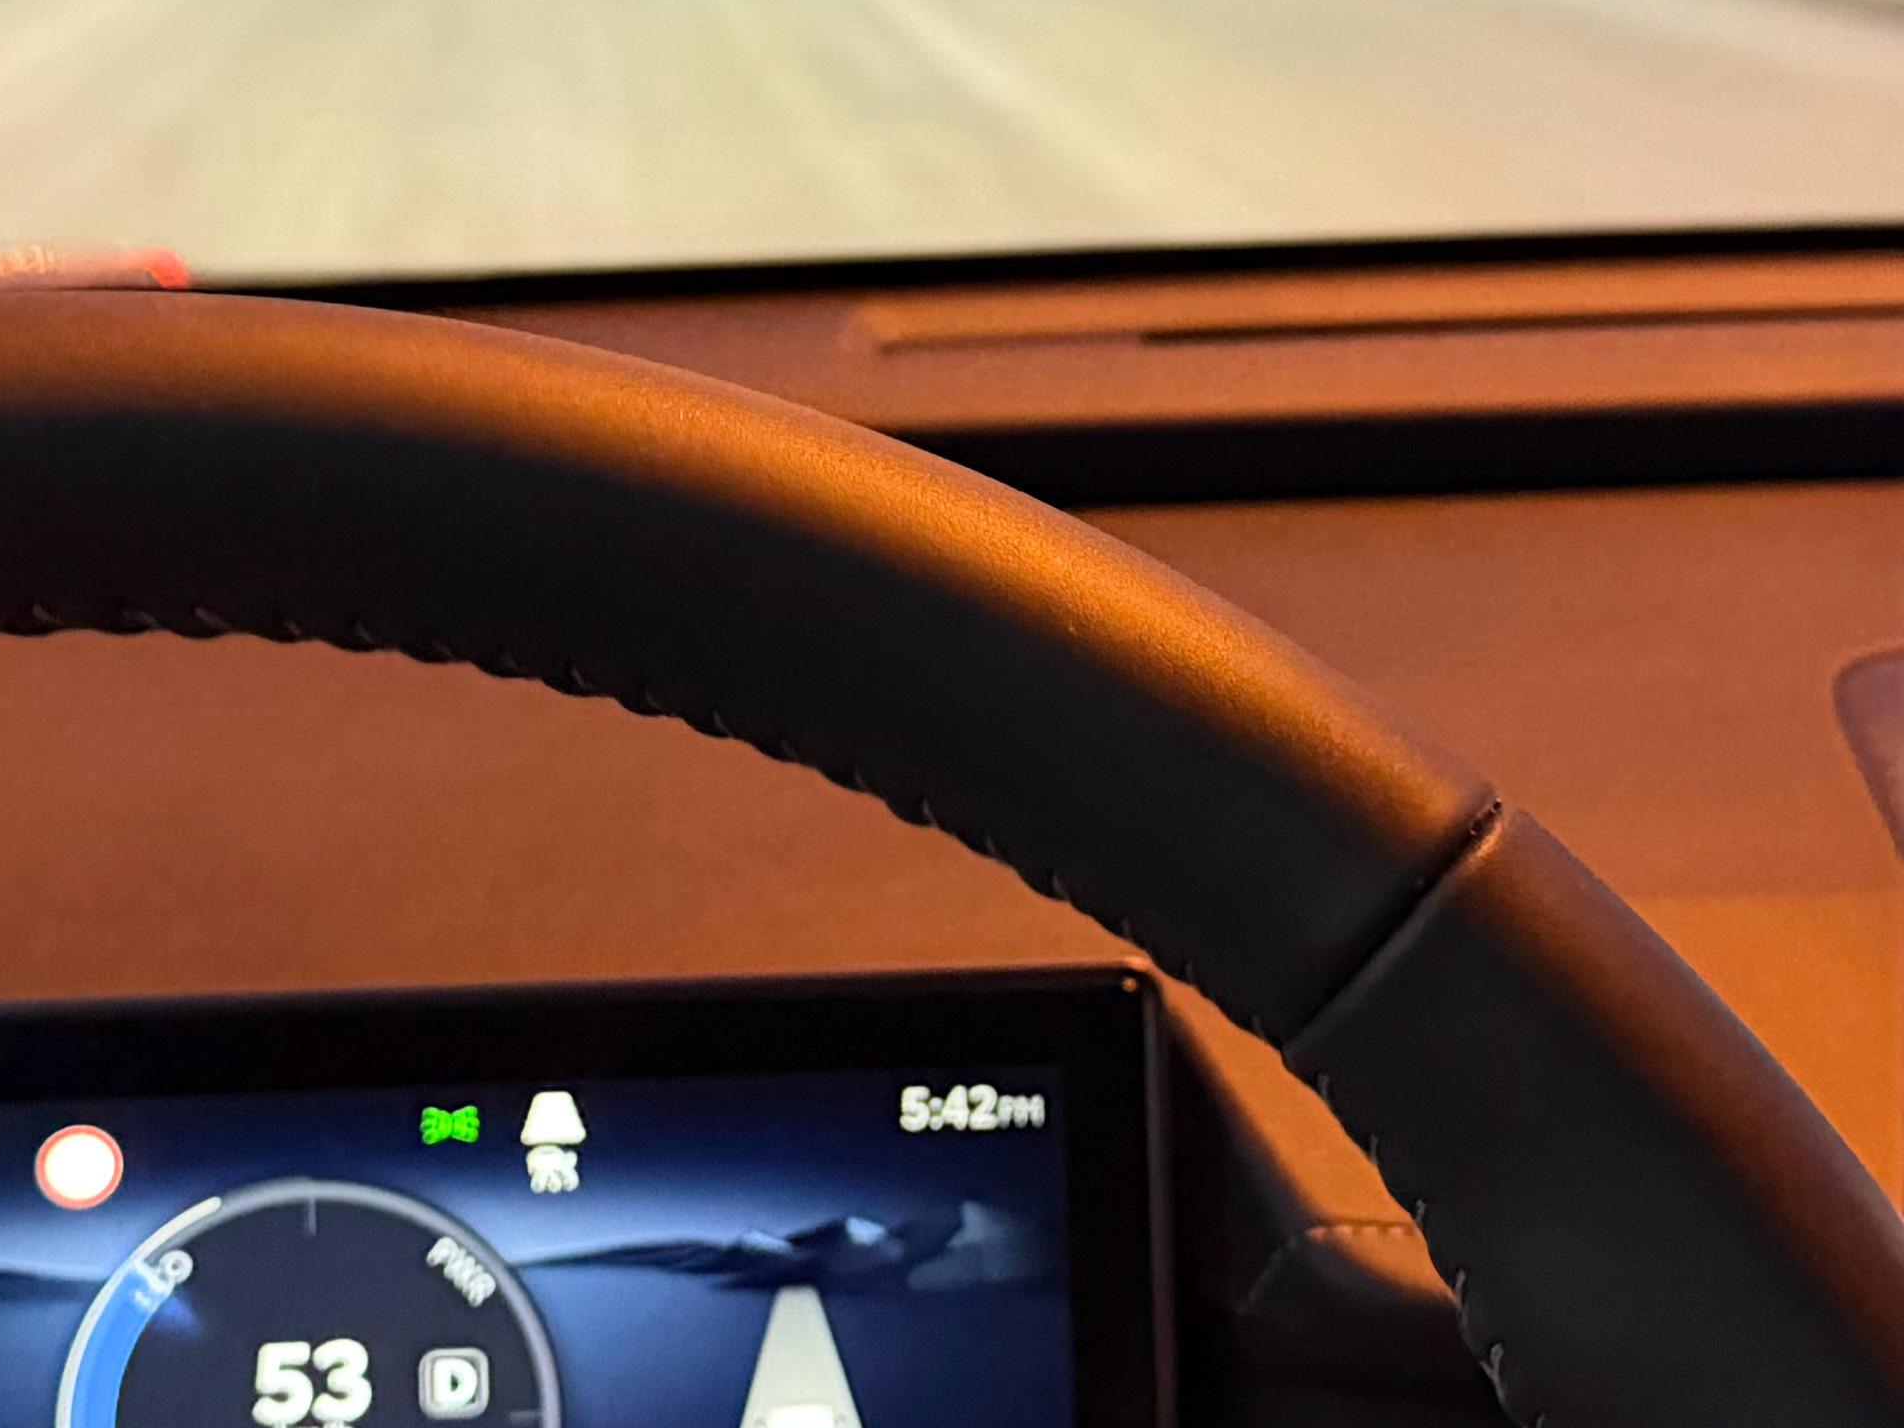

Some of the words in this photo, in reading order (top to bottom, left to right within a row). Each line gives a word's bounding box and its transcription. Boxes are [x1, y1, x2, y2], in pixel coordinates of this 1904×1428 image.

[426, 1236, 496, 1306] PWR
[252, 1339, 373, 1426] 53
[431, 1357, 479, 1408] D
